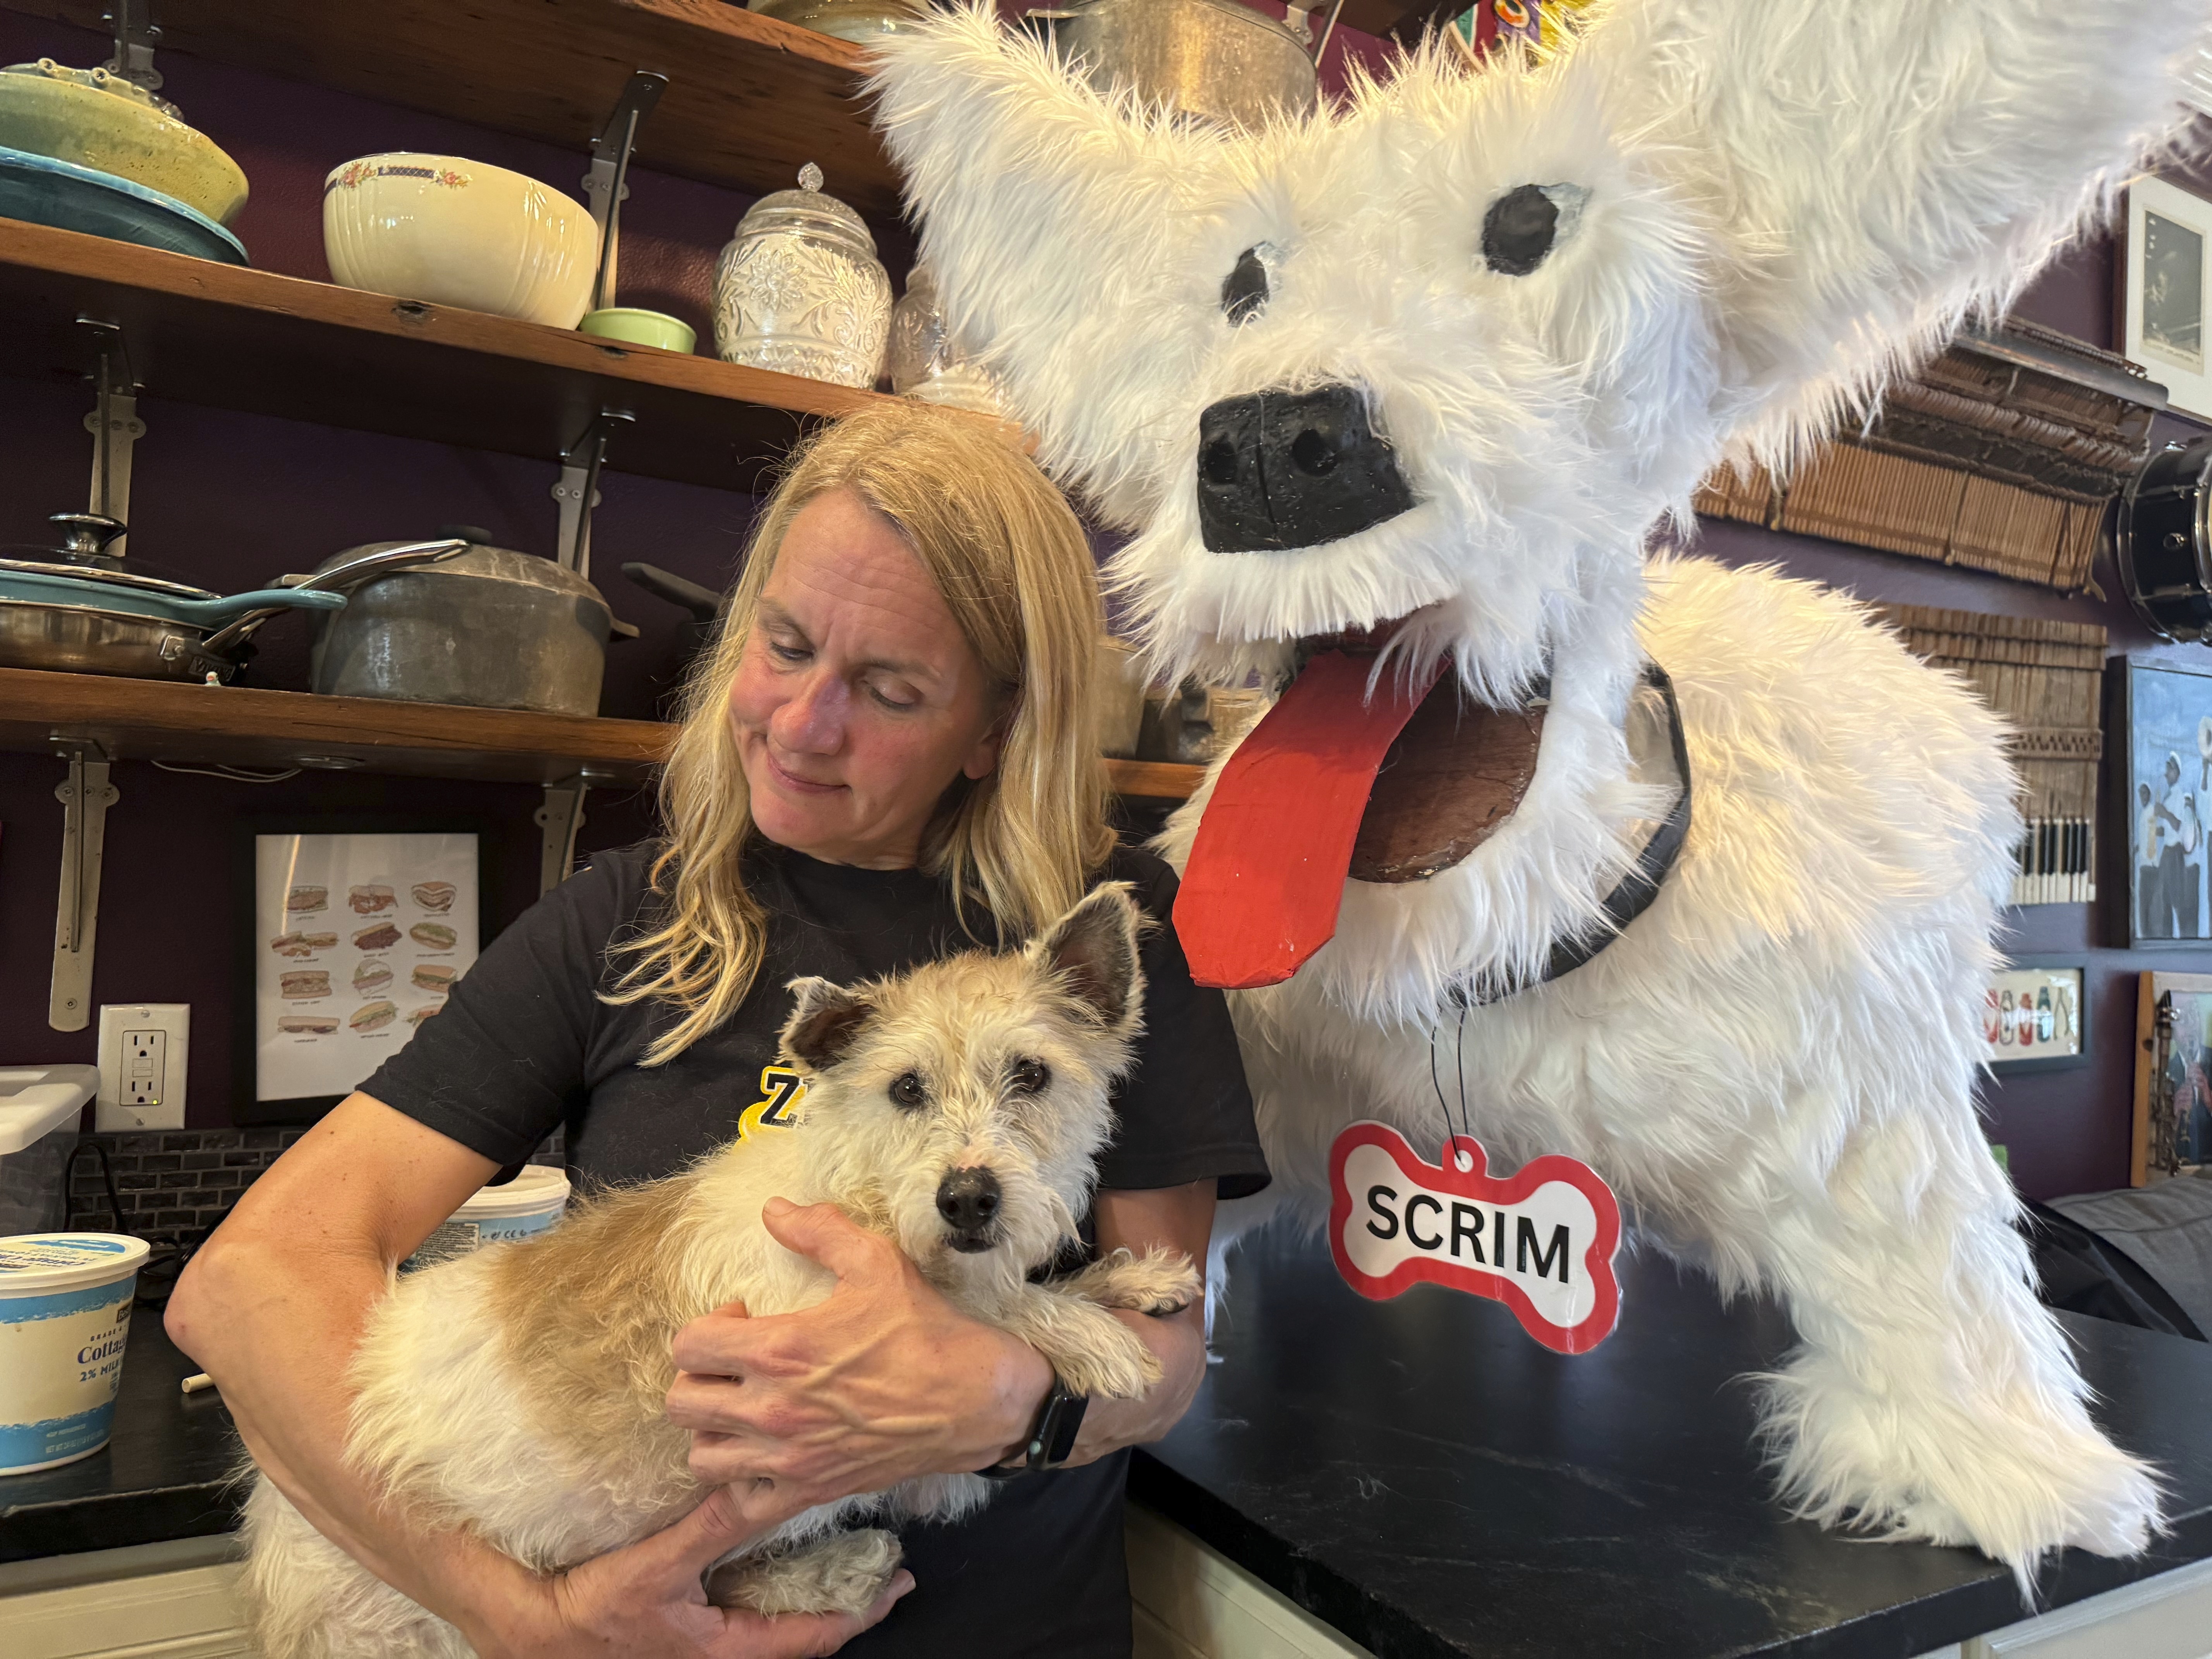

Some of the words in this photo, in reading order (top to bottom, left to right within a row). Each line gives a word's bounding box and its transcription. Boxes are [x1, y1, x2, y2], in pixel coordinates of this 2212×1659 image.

[760, 1072, 805, 1128] Z
[1366, 1185, 1570, 1284] SCRIM
[77, 1337, 126, 1364] Cottag
[80, 1368, 96, 1382] 2%
